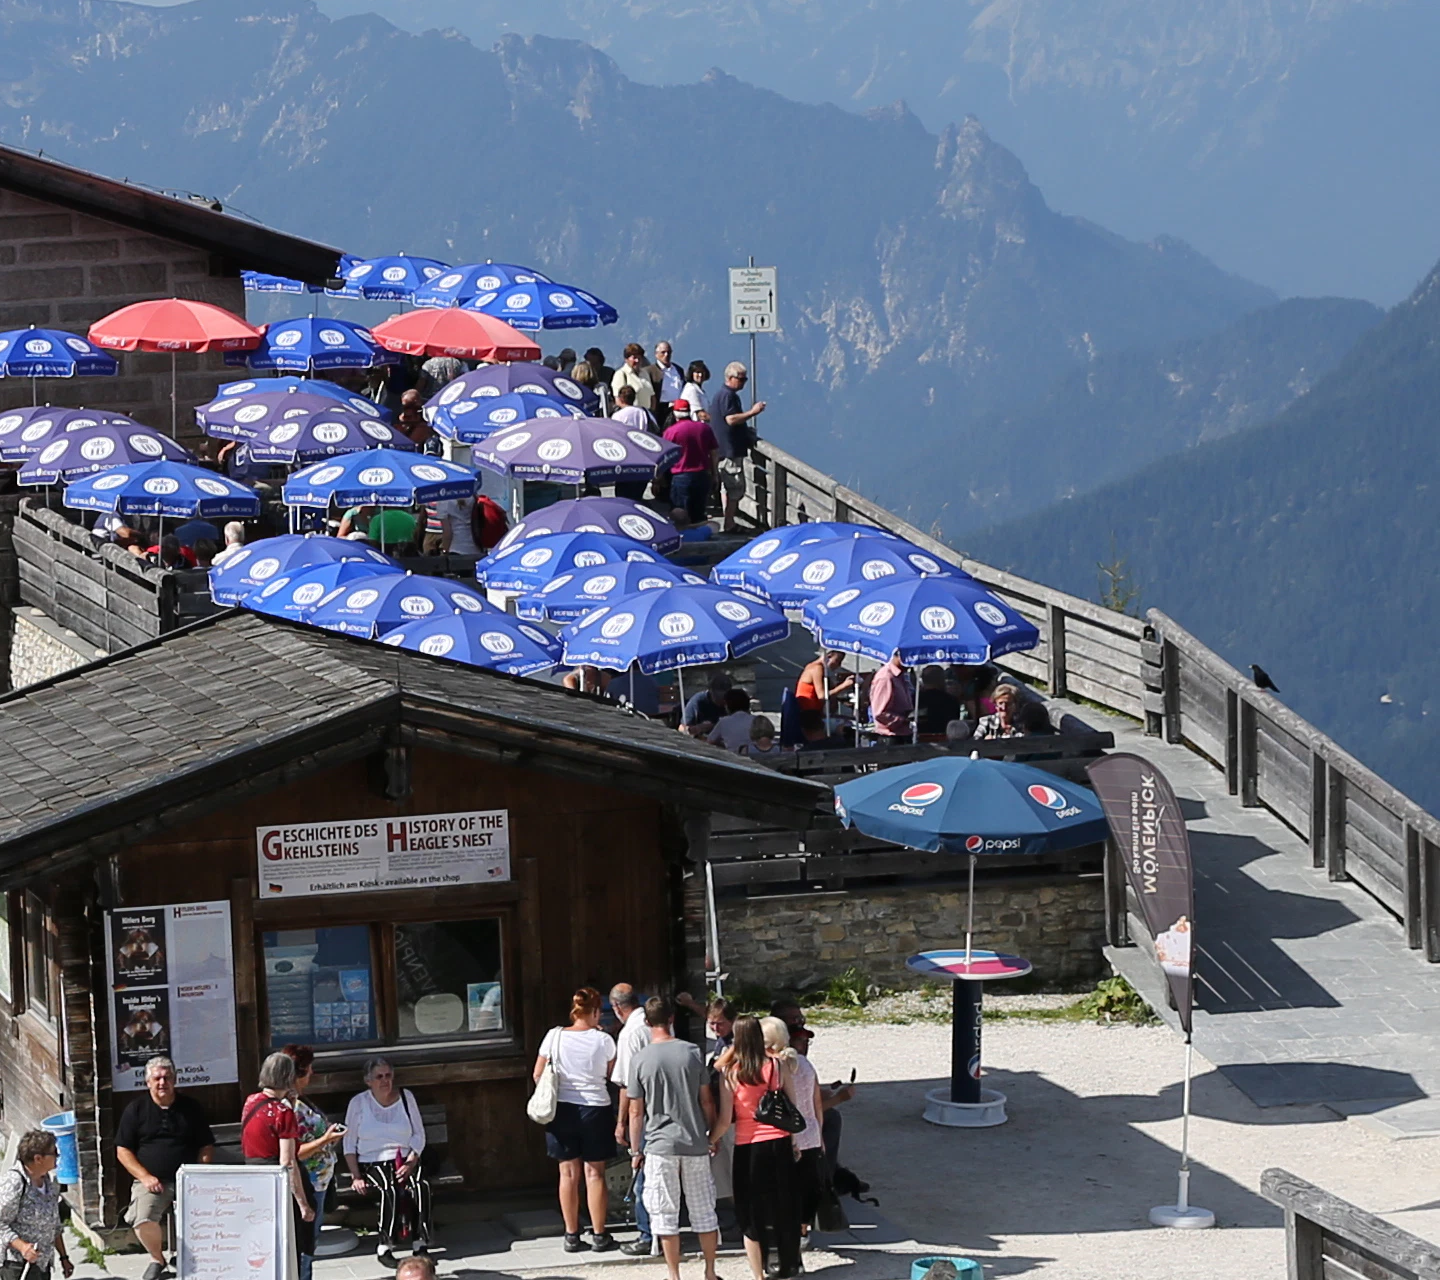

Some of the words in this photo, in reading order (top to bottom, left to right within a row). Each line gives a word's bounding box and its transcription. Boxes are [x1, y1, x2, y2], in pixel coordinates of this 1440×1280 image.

[888, 804, 926, 816] pepsi
[386, 817, 457, 853] HISTORY
[459, 817, 476, 830] OF
[478, 815, 503, 829] THE
[462, 832, 493, 847] NEST
[262, 826, 351, 861] GESCHICHTE
[354, 824, 378, 838] DES
[985, 838, 1021, 851] pepsi
[284, 842, 359, 860] KEHLSTEINS
[310, 881, 345, 892] Erhältlich
[359, 879, 379, 888] Kiosk
[385, 874, 418, 886] available
[428, 875, 441, 883] the
[442, 874, 460, 884] shop
[142, 915, 155, 924] Berg
[185, 1064, 204, 1074] Kiosk
[192, 1075, 210, 1084] shop
